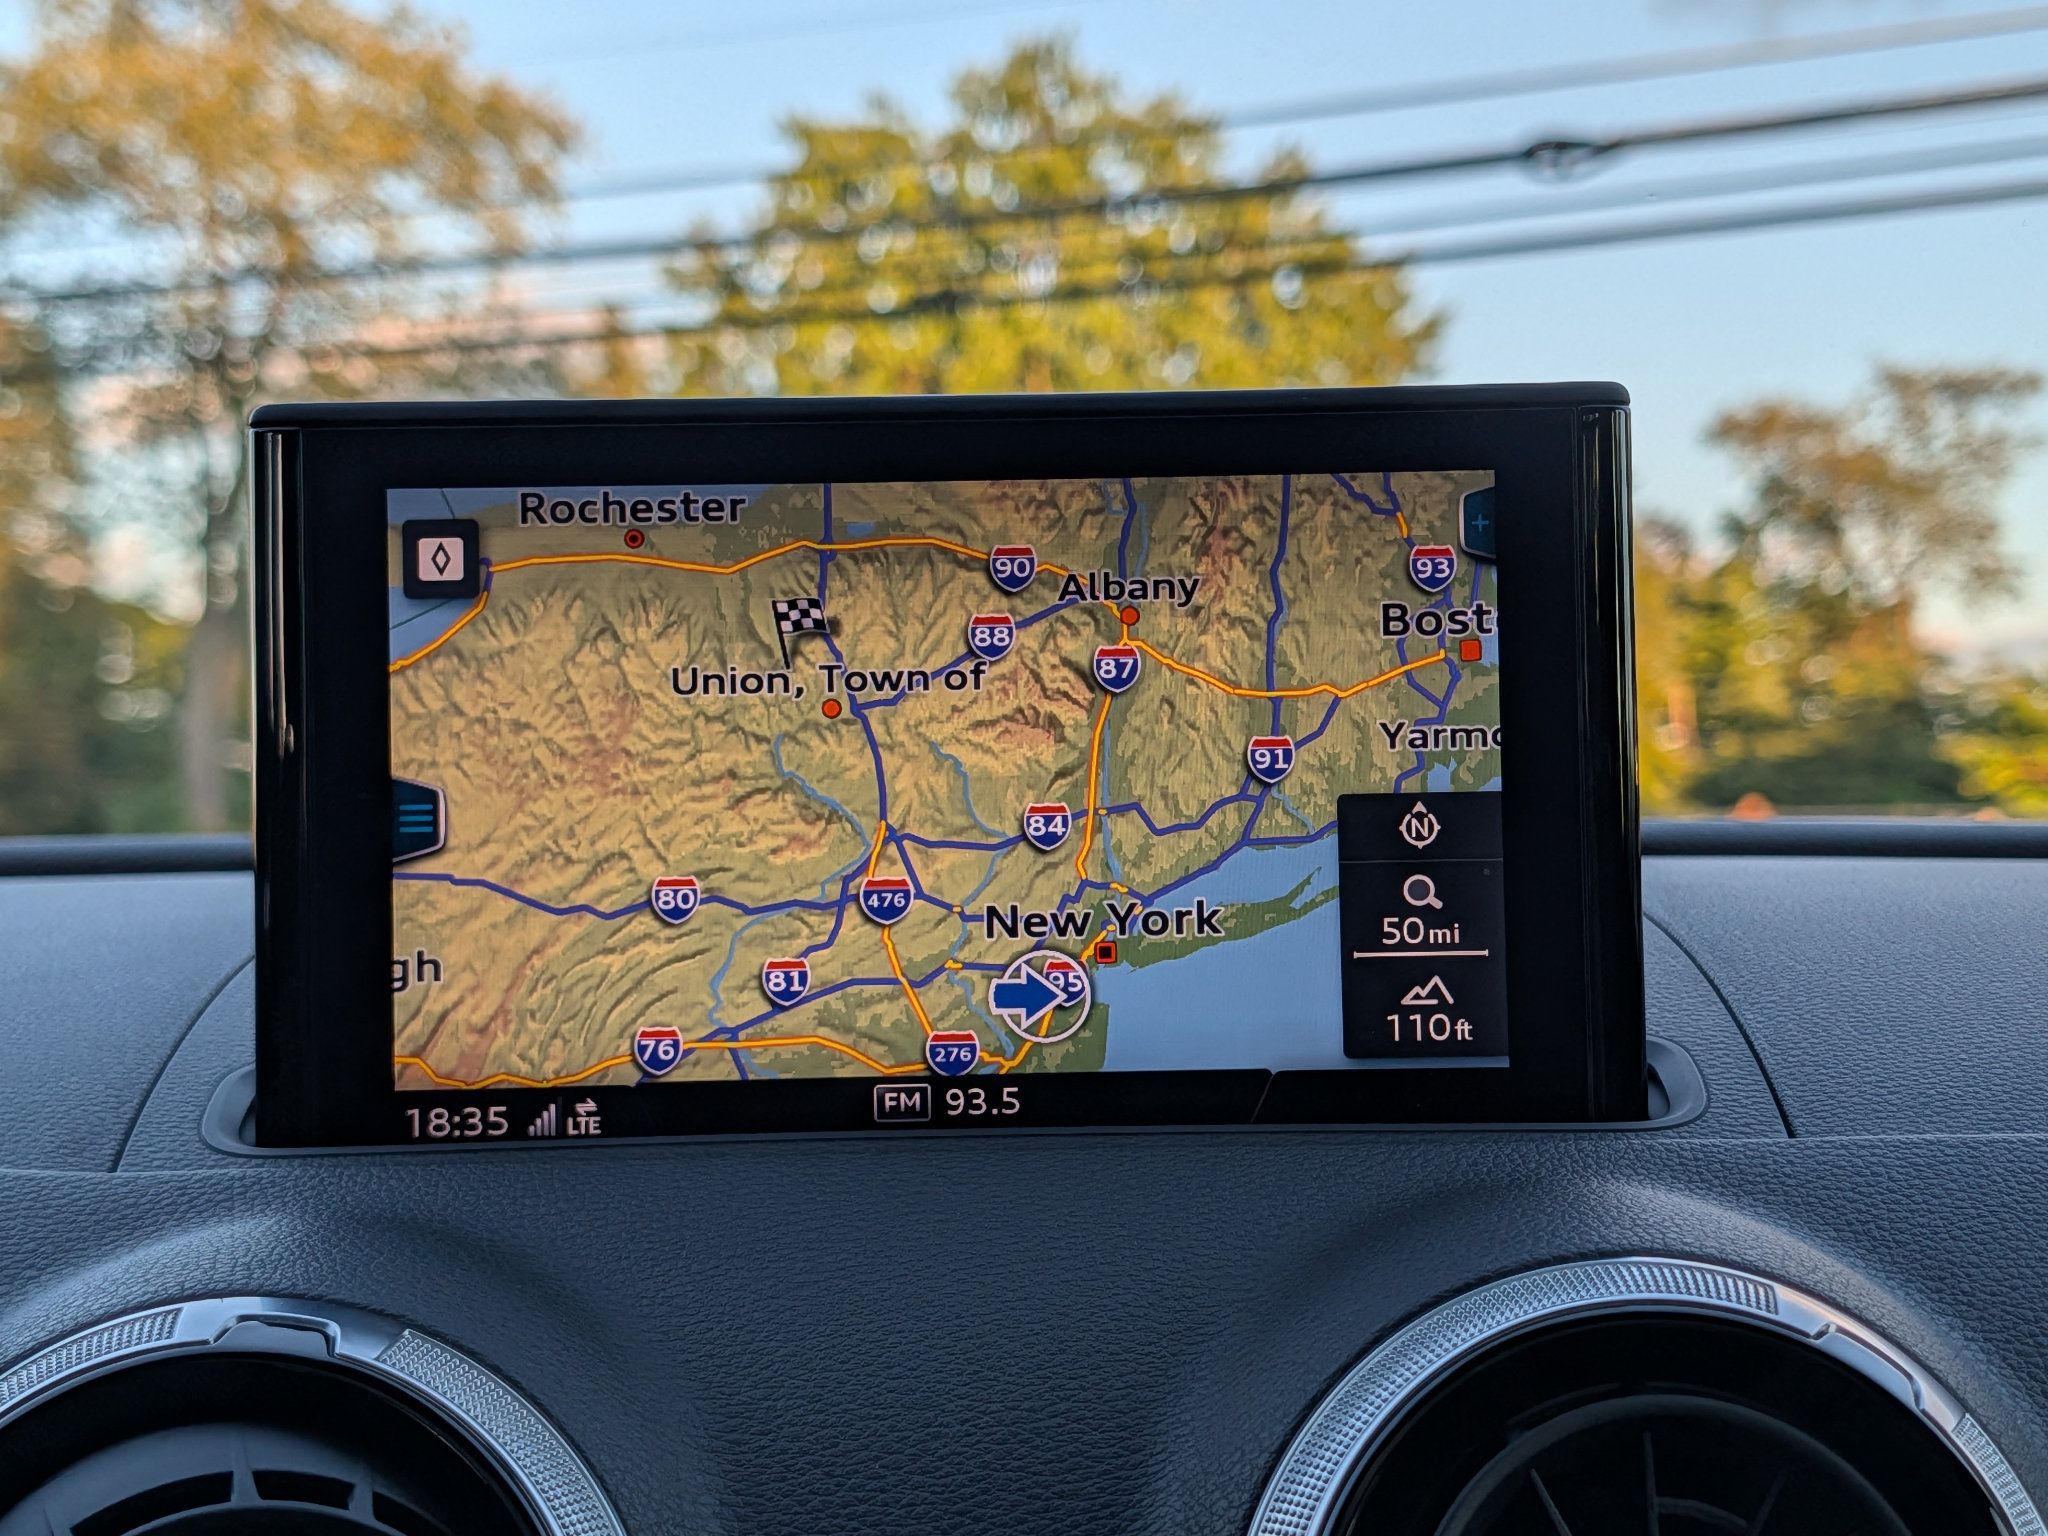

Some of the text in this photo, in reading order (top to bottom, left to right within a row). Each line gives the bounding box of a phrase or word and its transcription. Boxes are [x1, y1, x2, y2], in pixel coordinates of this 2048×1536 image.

[520, 492, 746, 525] Rochester
[996, 558, 1031, 578] 90
[1417, 557, 1451, 578] 93
[1059, 573, 1200, 606] Albany
[974, 627, 1010, 647] 88
[1099, 658, 1134, 678] 87
[673, 662, 988, 699] Union, Town of
[1255, 749, 1288, 769] 91
[1029, 816, 1065, 836] 84
[658, 889, 694, 910] 80
[868, 892, 906, 908] 476
[986, 902, 1221, 939] New York
[769, 971, 802, 992] 81
[1049, 972, 1083, 992] 95
[641, 1040, 675, 1060] 76
[934, 1047, 972, 1062] 276
[884, 1087, 1020, 1116] FM 93.5
[404, 1106, 509, 1138] 18:35
[566, 1116, 602, 1136] LTE
